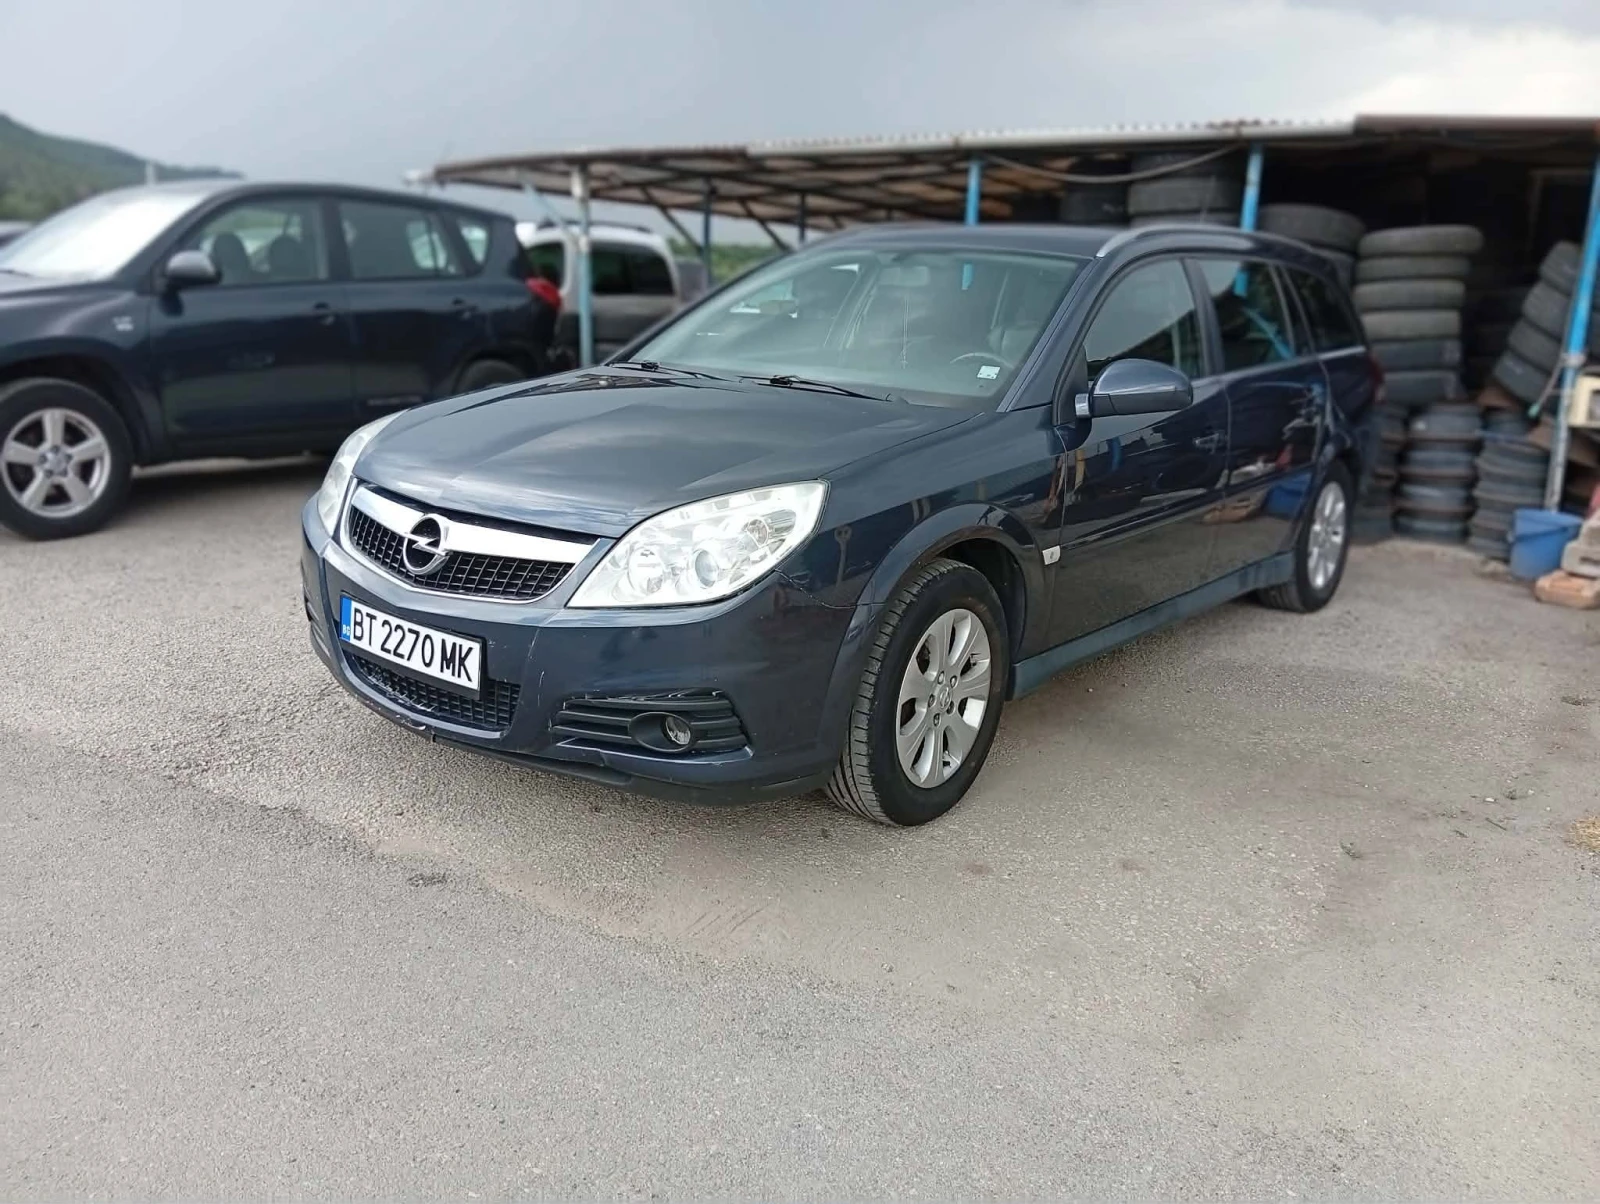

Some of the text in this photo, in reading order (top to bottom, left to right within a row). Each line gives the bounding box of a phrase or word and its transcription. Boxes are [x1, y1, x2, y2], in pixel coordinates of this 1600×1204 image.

[342, 624, 350, 636] BG
[353, 607, 474, 682] BT 2270 MK
